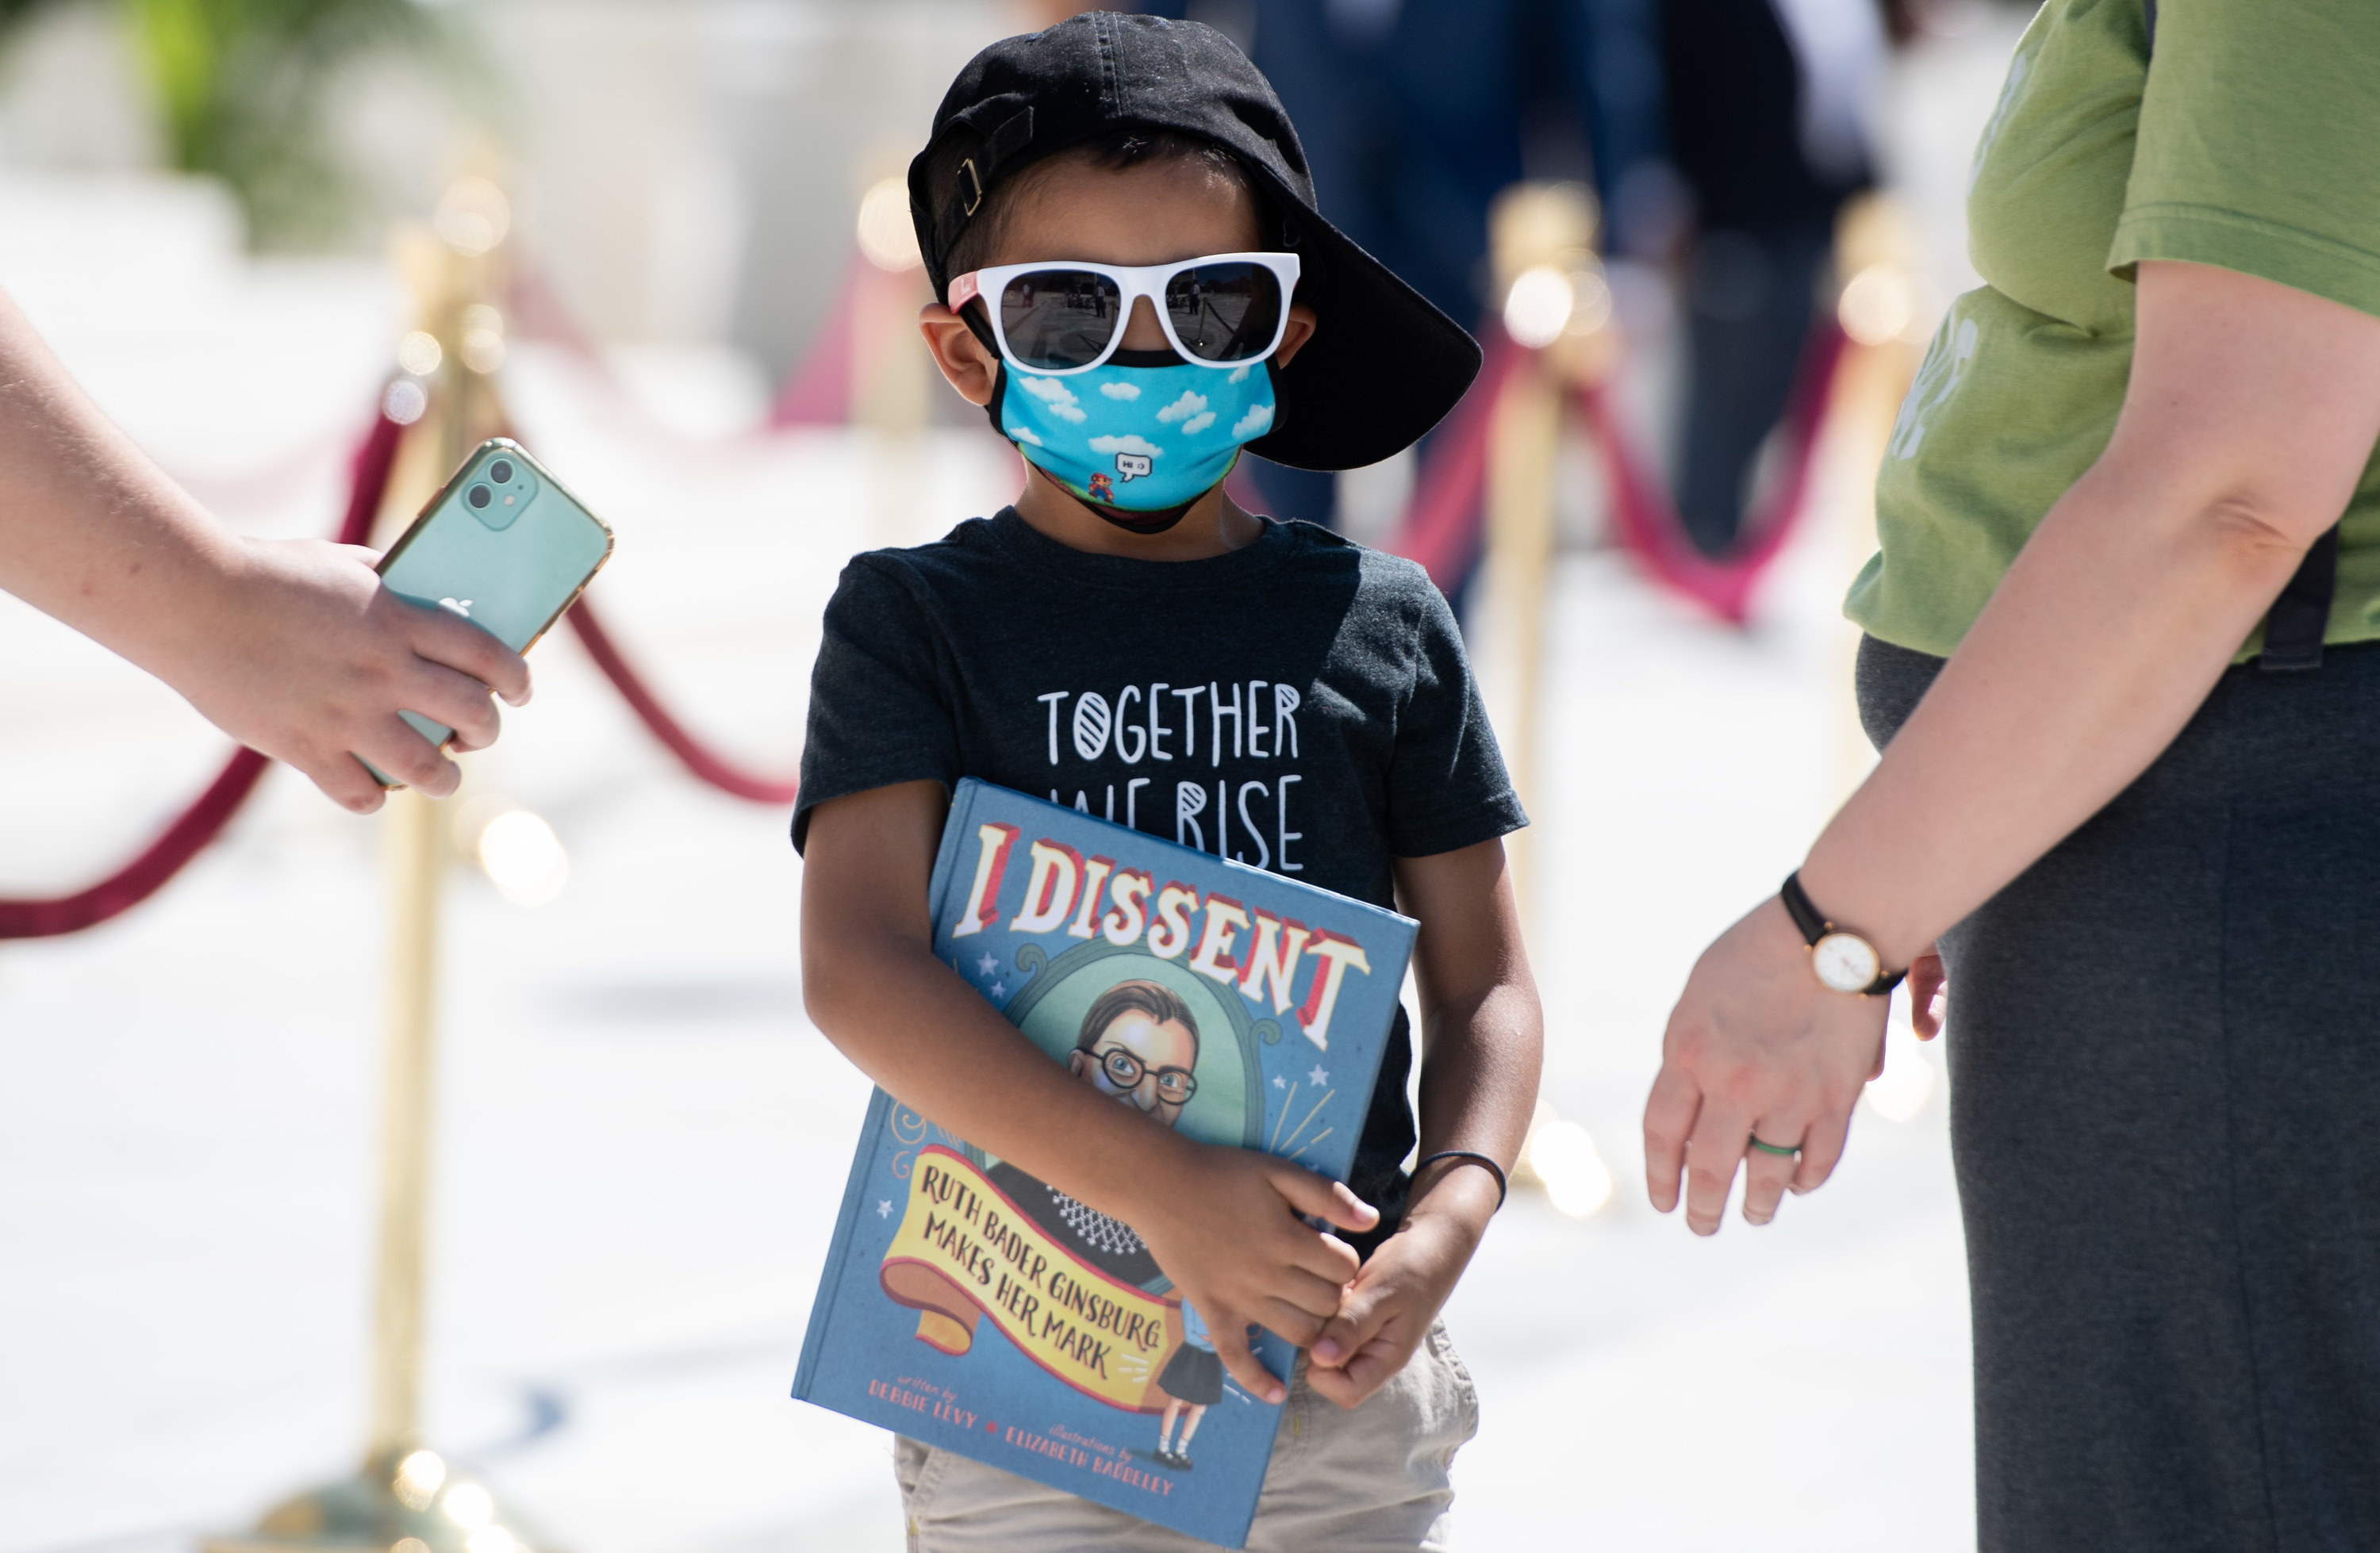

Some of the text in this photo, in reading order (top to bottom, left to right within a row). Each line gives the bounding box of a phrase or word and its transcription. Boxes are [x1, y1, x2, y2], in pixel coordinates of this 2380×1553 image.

[1037, 680, 1300, 767] TOGETHER
[1177, 774, 1303, 871] RISE
[953, 822, 1371, 1051] I DISSENT
[921, 1164, 1161, 1352] RUTH BADER GINSBURG
[923, 1210, 1111, 1381] MAKES HER MARK
[869, 1379, 977, 1428] DEBBIE LEVY
[897, 1375, 958, 1403] written by
[1005, 1426, 1173, 1497] ELIZABETH BADDELEY
[1049, 1424, 1133, 1464] illustrations by
